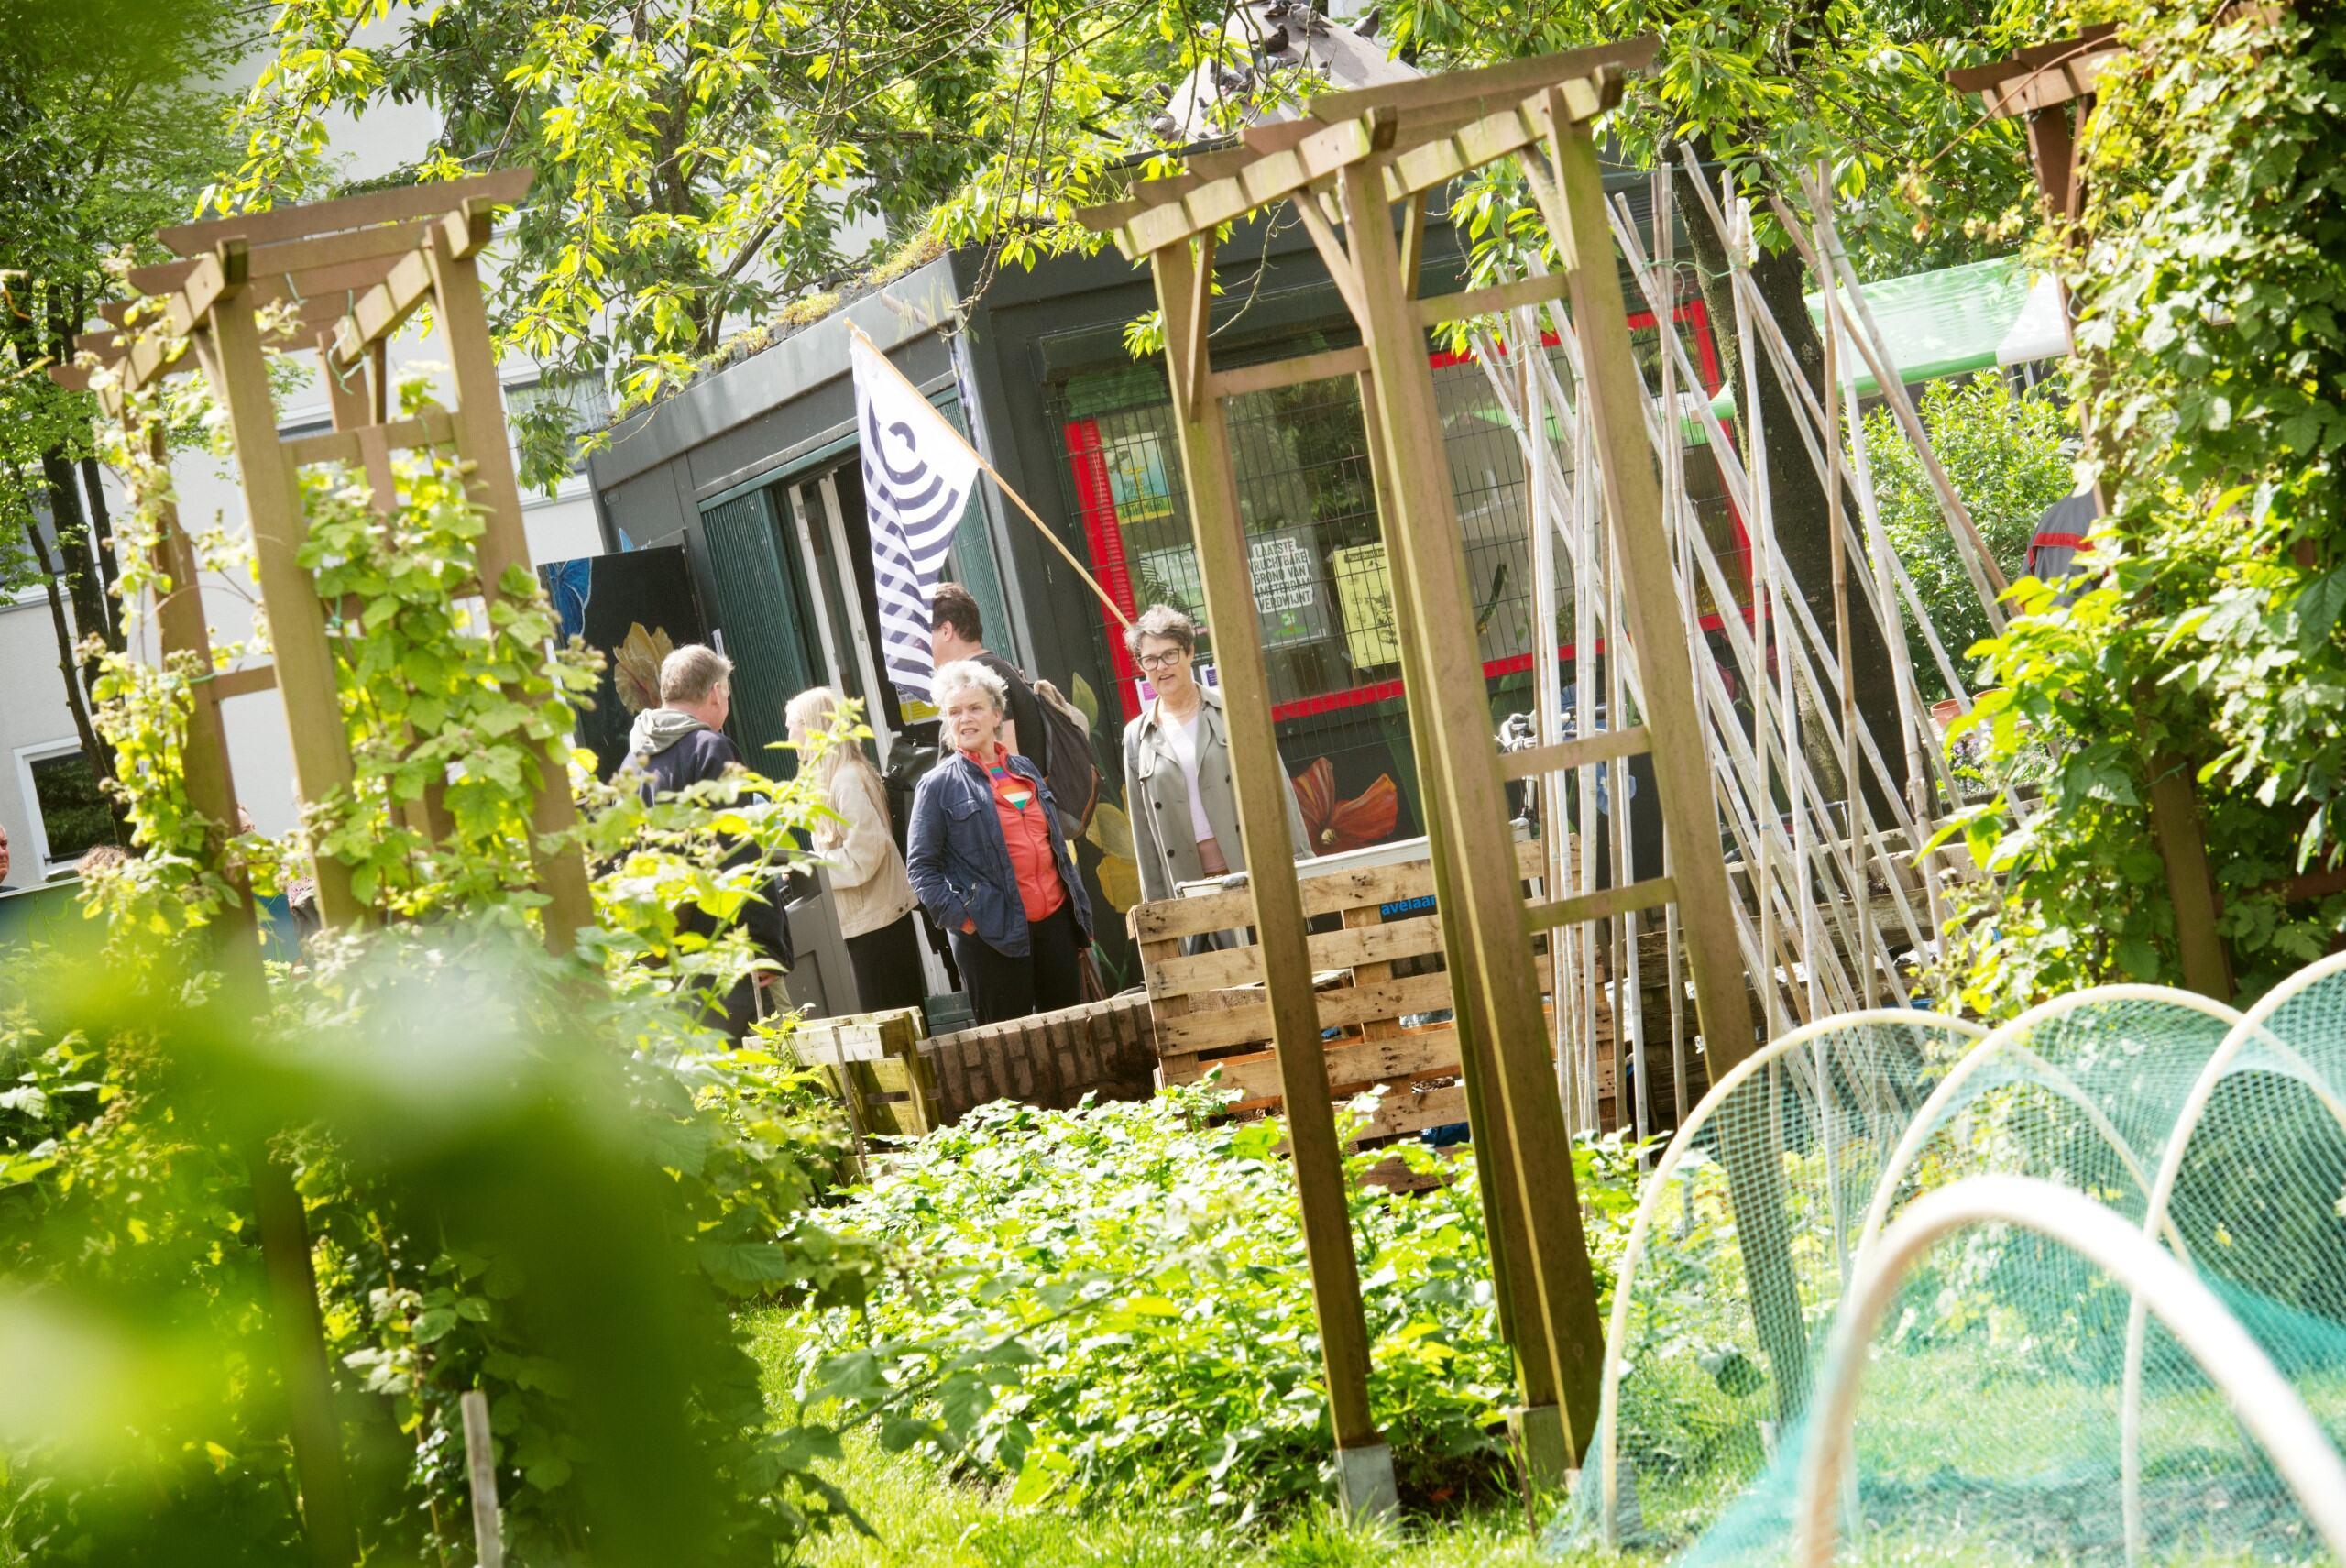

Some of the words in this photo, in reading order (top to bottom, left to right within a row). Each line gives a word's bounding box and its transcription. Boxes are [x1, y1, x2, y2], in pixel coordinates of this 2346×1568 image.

[1255, 540, 1295, 558] LAATSTE
[1250, 552, 1307, 572] VRUCHTBARE
[1254, 569, 1285, 585] GROND
[1288, 565, 1307, 578] VAN
[1255, 577, 1311, 598] AMSTERDAM
[1259, 590, 1310, 610] VERDWIJNT
